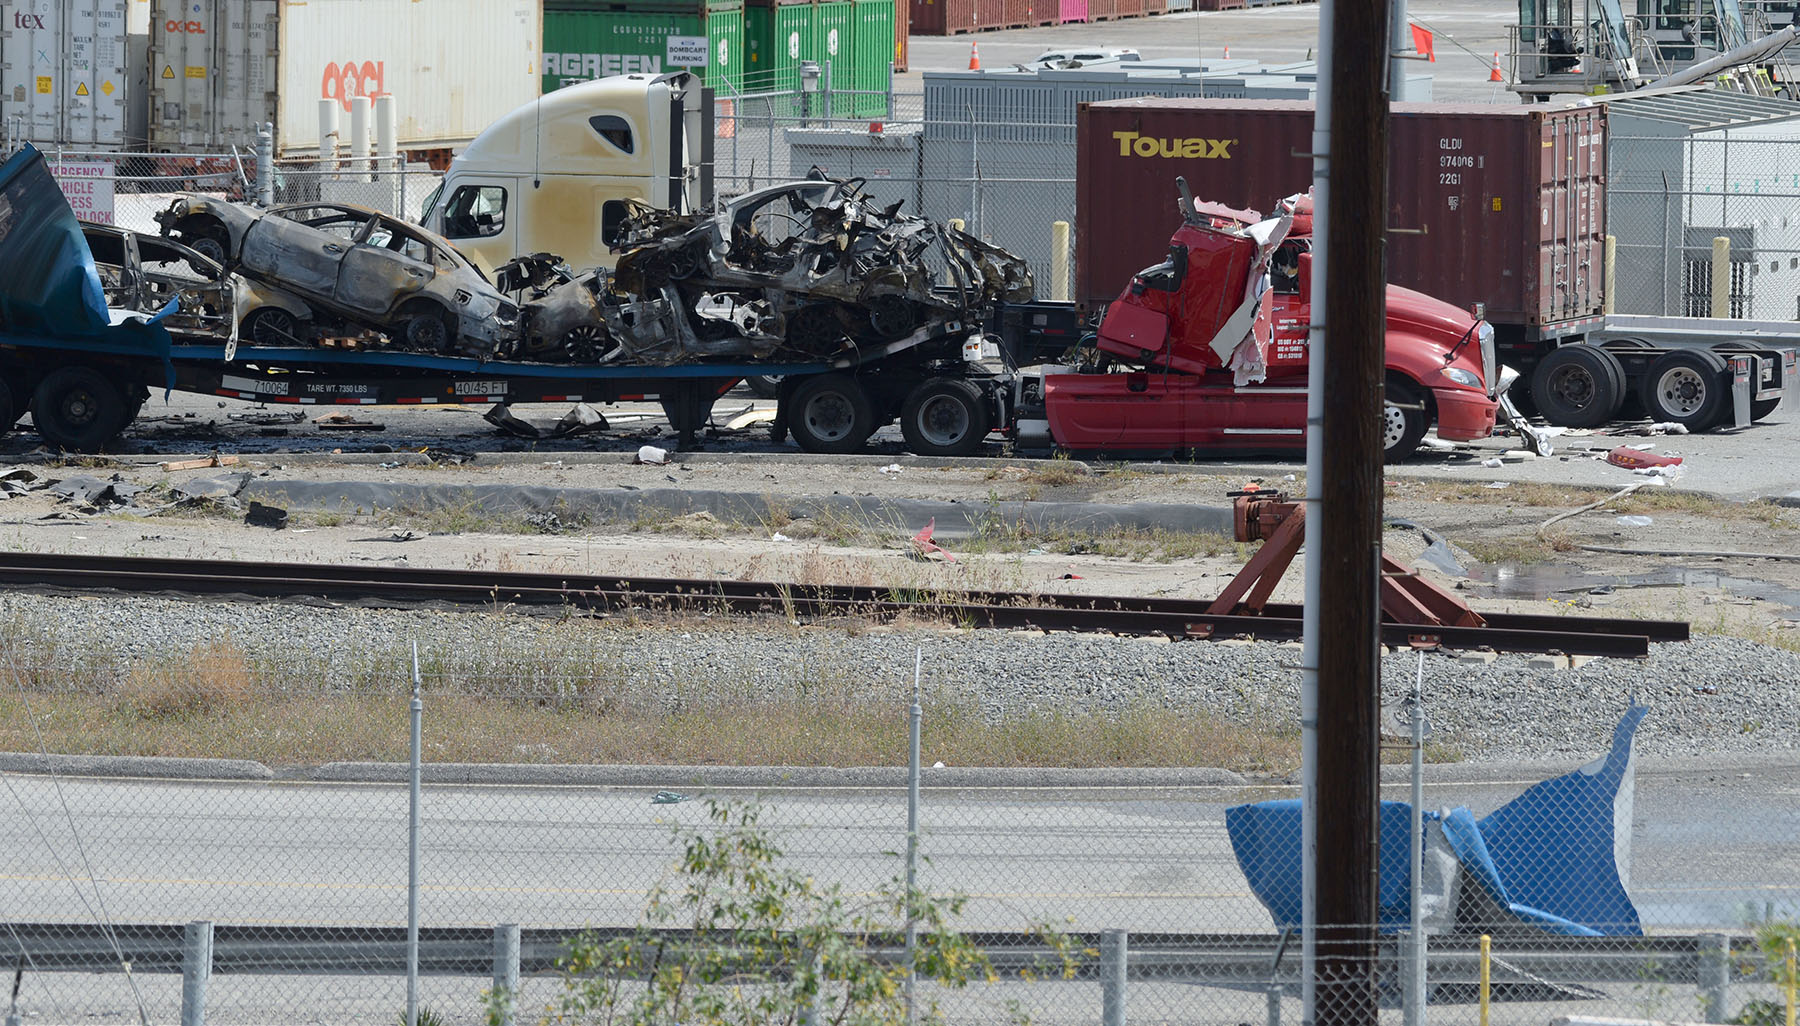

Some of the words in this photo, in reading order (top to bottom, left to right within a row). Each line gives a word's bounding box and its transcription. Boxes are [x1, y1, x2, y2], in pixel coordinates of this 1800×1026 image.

[14, 9, 45, 30] tex
[1440, 138, 1462, 150] GLDU
[1440, 173, 1461, 185] 22G1
[254, 380, 288, 394] 710064
[307, 384, 324, 393] TARE
[326, 384, 338, 393] WT.
[354, 384, 368, 393] LBS
[456, 382, 489, 394] 40/45
[492, 381, 507, 393] FT
